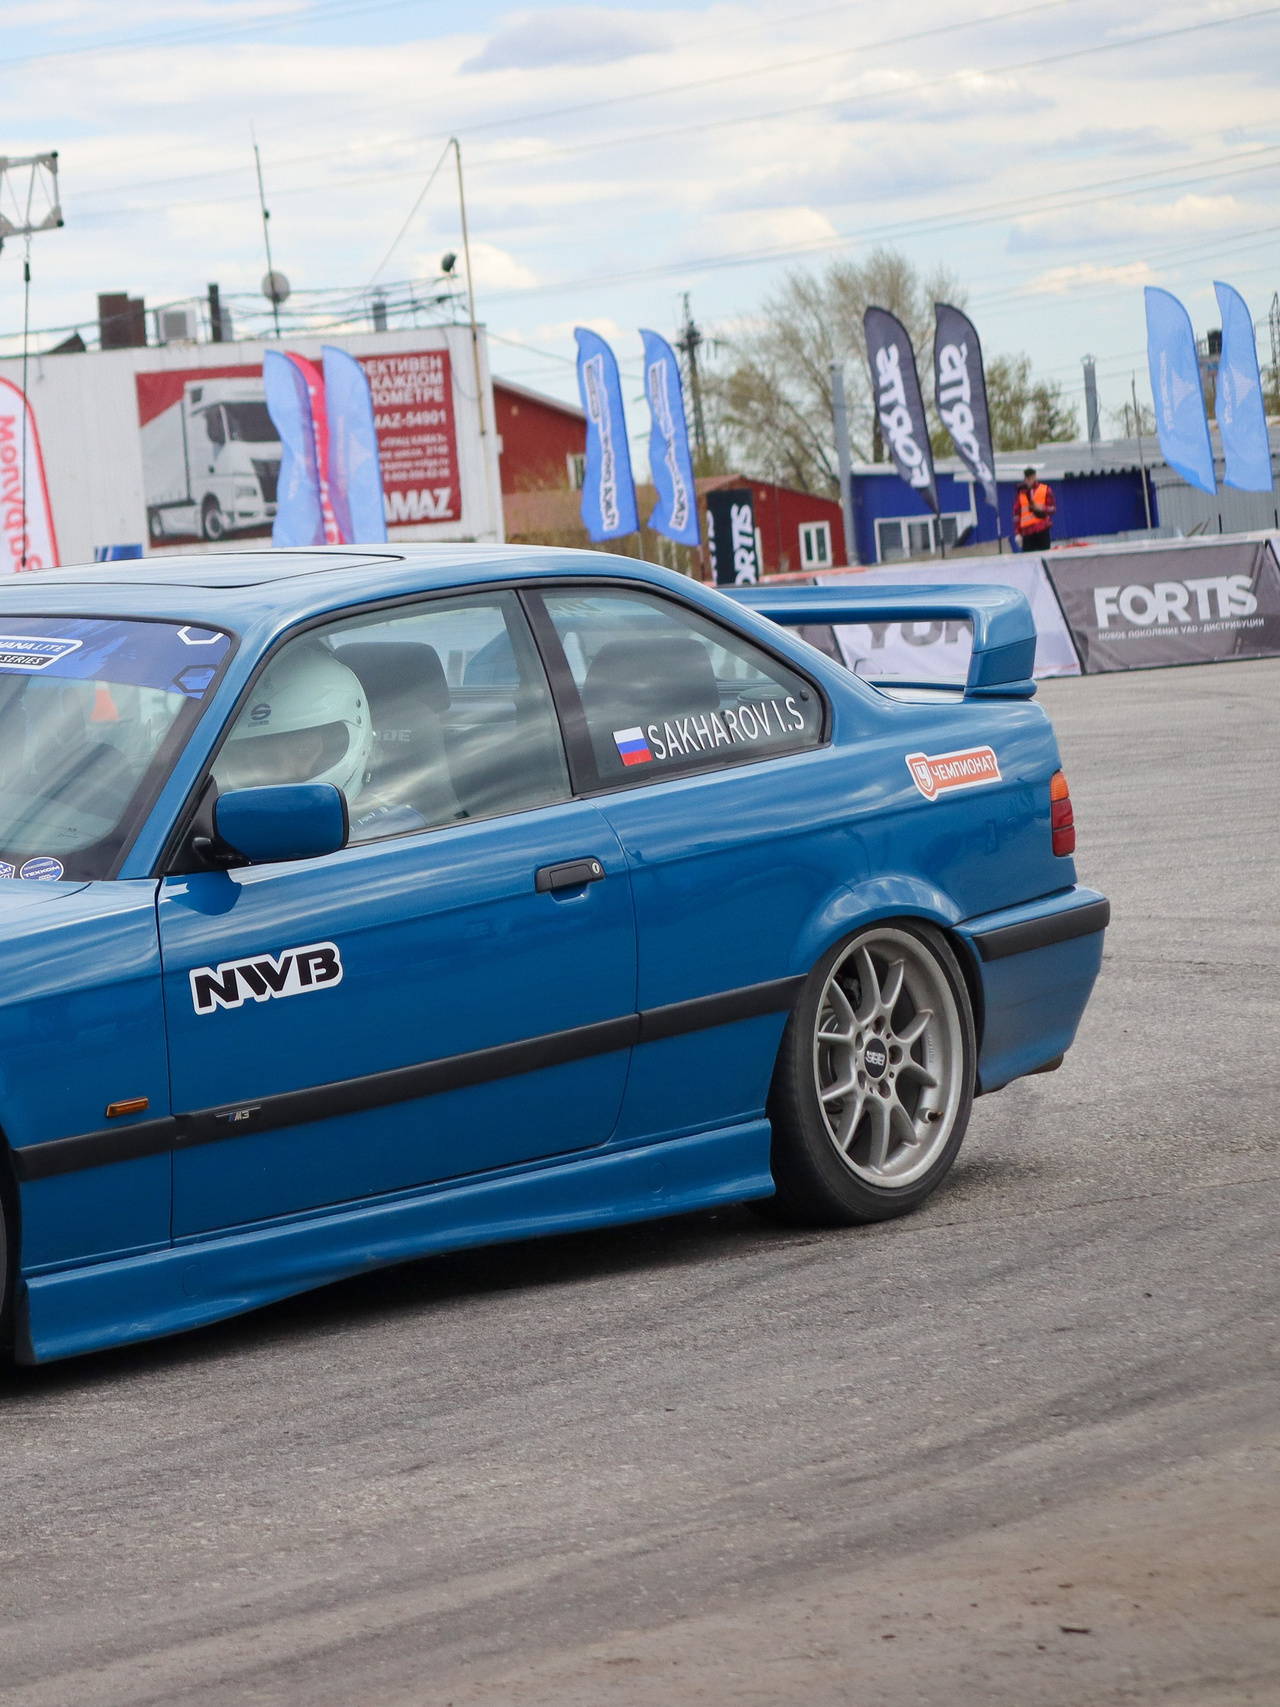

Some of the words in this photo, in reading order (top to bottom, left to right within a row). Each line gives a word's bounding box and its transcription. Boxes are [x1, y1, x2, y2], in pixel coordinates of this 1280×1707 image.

[362, 355, 443, 375] ЕКТИВЕН
[1094, 575, 1258, 629] FORTIS
[1128, 627, 1180, 639] ПОКОЛЕНИЕ
[32, 643, 66, 652] LITE
[1, 655, 43, 665] SERIES
[647, 701, 771, 760] SAKHAROV
[770, 696, 805, 733] I.S
[930, 754, 995, 780] ЧЕМПИОНАТ
[194, 948, 340, 1009] NWB
[865, 1051, 885, 1066] BBS
[232, 1110, 250, 1121] M3
